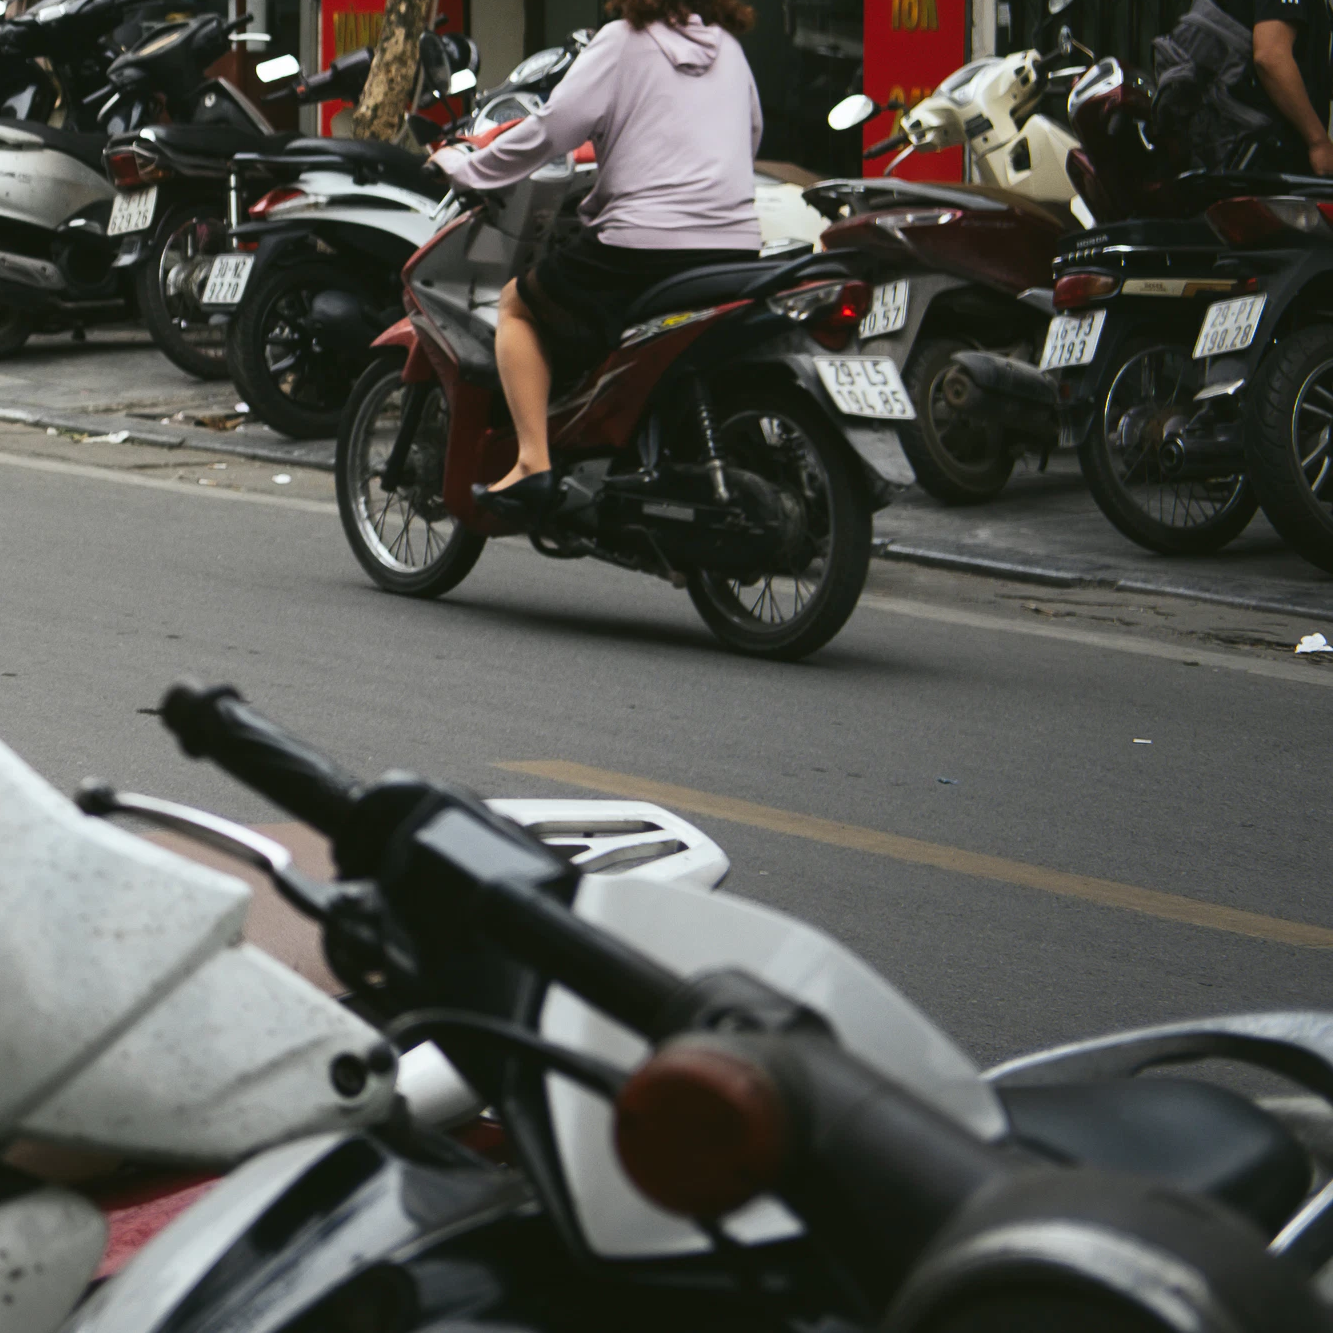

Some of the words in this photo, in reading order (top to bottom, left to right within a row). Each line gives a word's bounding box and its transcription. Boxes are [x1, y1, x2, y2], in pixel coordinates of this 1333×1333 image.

[333, 3, 386, 57] VÀN
[1076, 233, 1109, 249] HONDA
[1213, 299, 1257, 325] 29-P1
